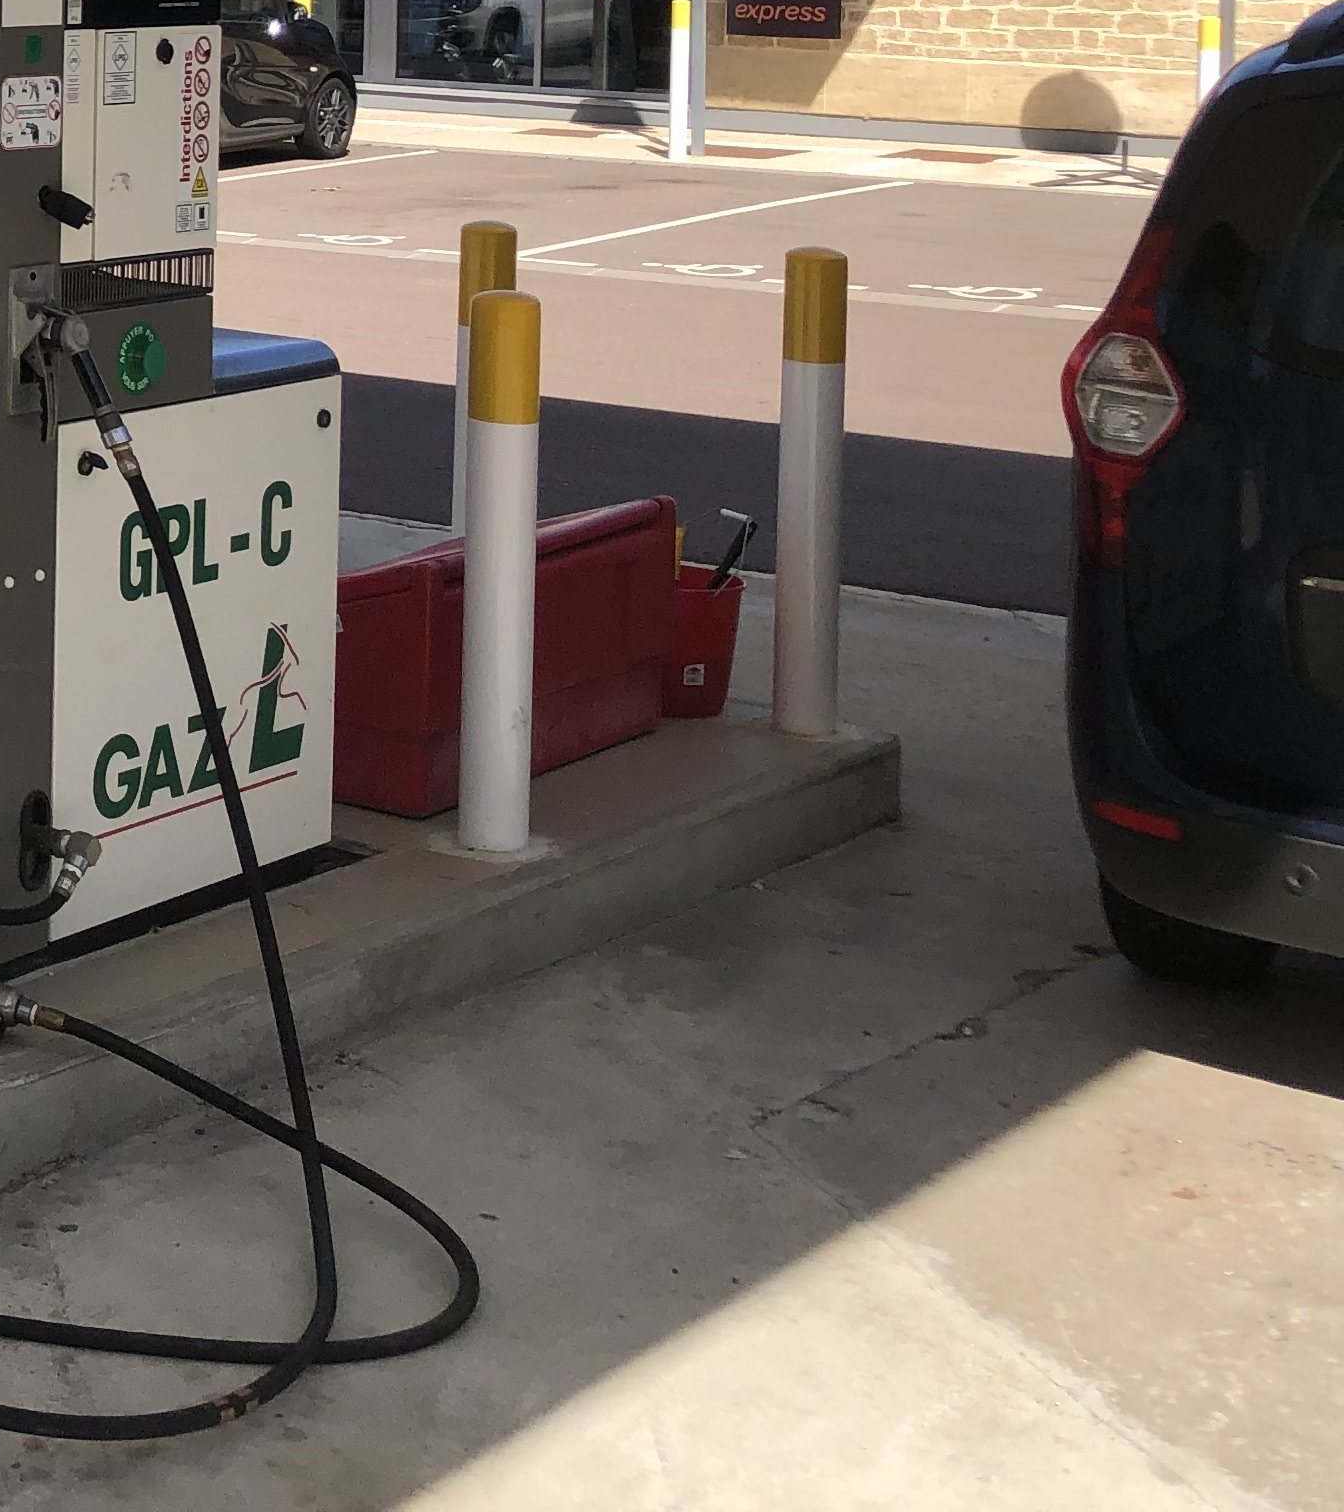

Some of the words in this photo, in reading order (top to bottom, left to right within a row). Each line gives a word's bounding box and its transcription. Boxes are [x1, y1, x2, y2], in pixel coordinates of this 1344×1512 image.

[735, 3, 827, 24] express
[180, 50, 193, 182] Interdictions
[93, 705, 227, 819] GAZ
